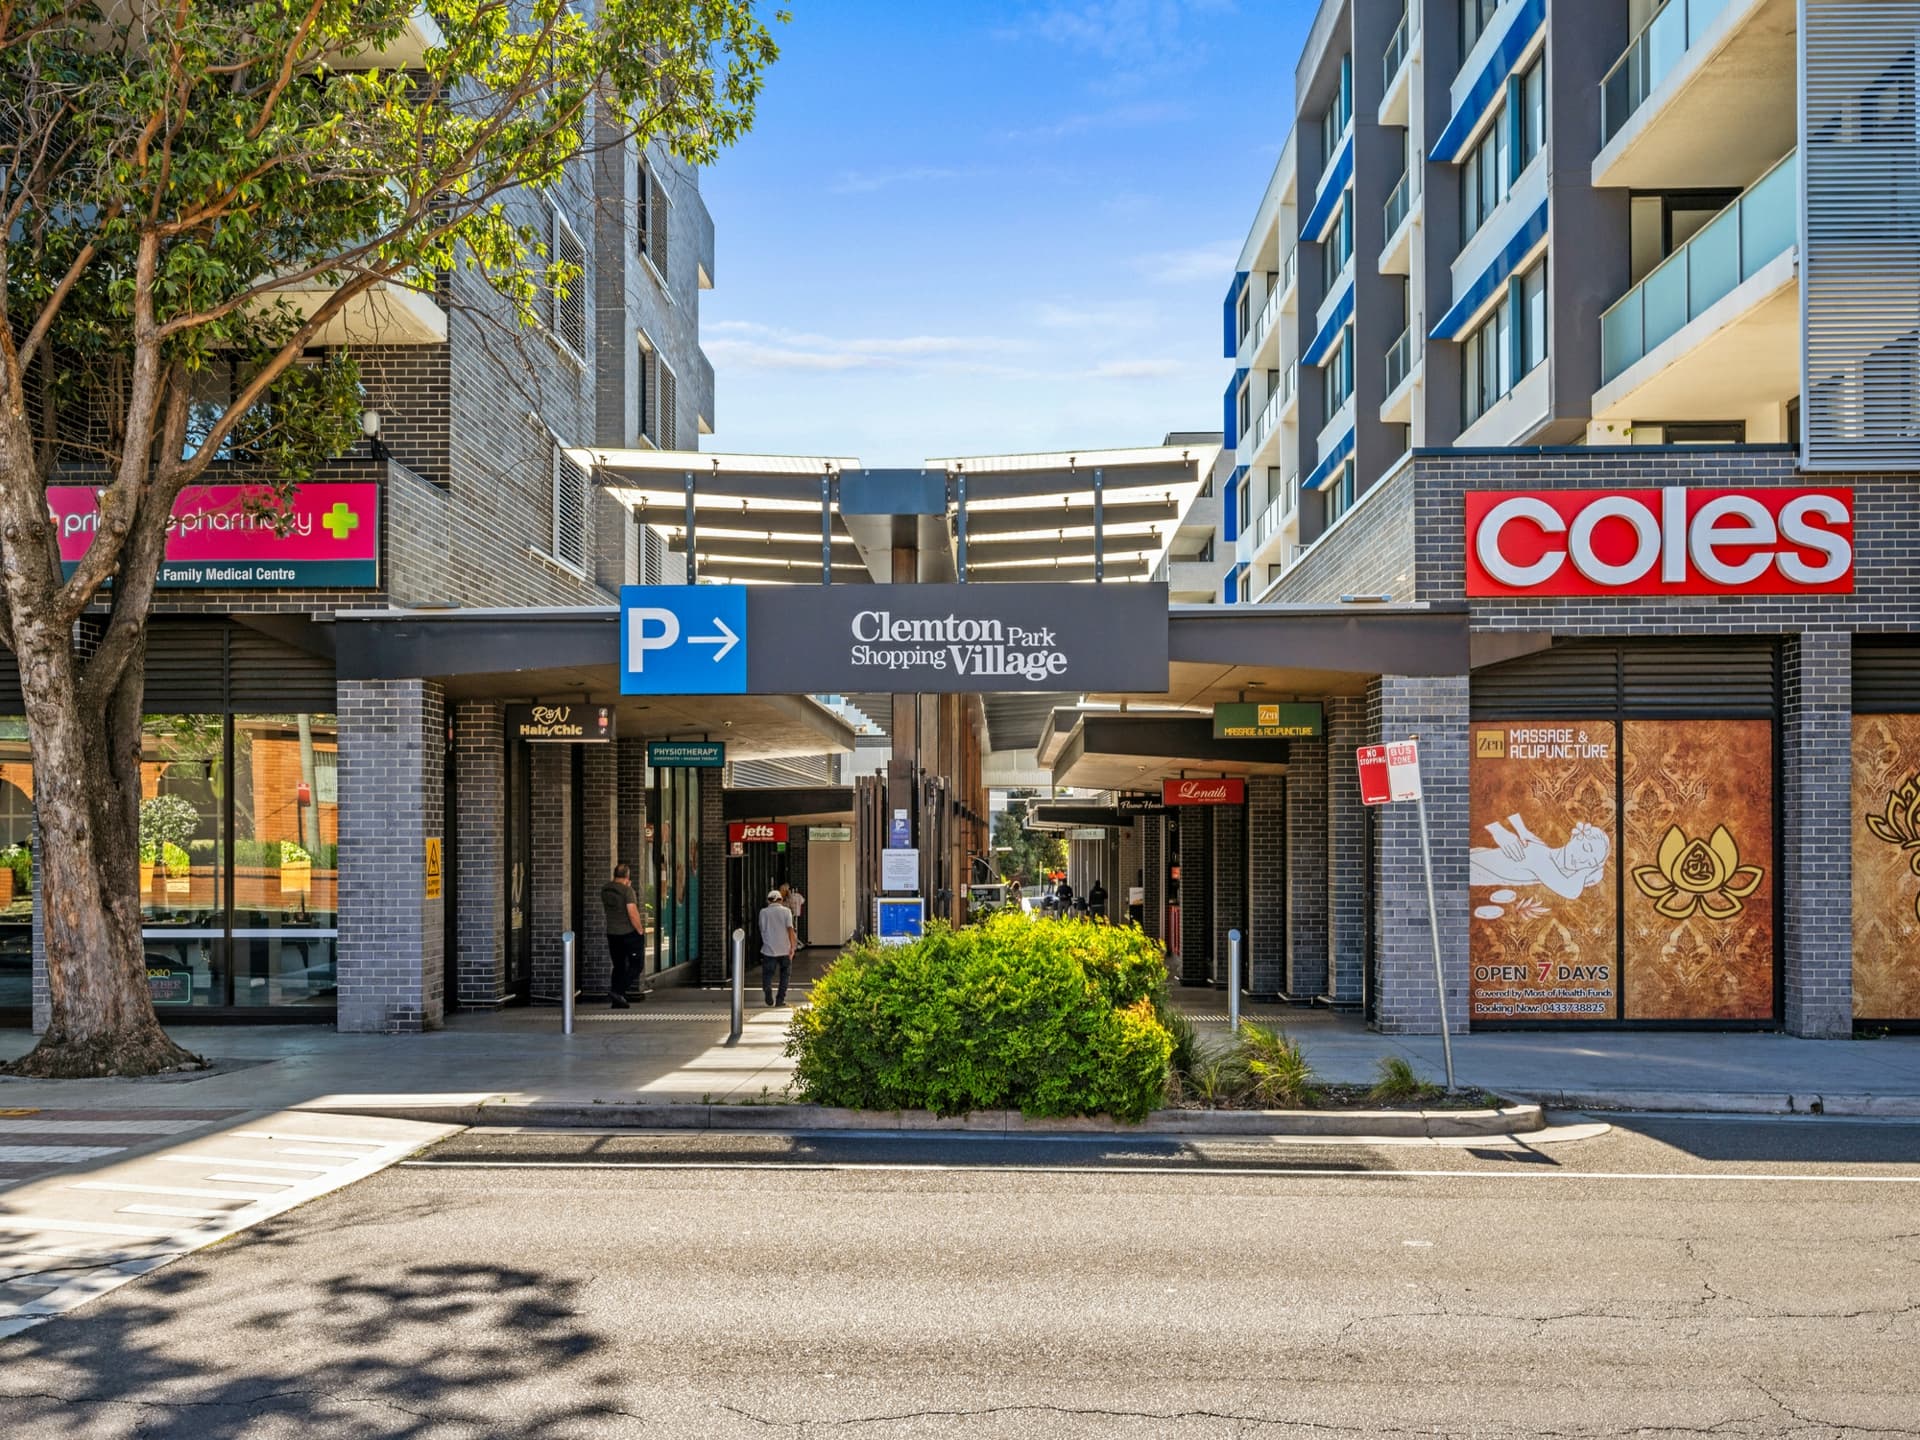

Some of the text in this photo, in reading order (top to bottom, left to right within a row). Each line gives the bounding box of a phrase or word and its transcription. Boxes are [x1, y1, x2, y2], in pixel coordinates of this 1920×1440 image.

[1476, 486, 1852, 586] coles
[163, 568, 202, 582] Family
[206, 568, 252, 580] Medical
[256, 568, 296, 580] Centre
[851, 611, 1056, 647] Clemton Park
[628, 607, 680, 673] P
[851, 645, 1068, 681] Shopping Village
[1260, 710, 1278, 720] Zen
[1224, 728, 1256, 736] MASSAGE
[1264, 727, 1313, 736] ACUPUNCTURE
[1510, 729, 1588, 743] MASSAGE &
[1479, 738, 1503, 751] Zen
[654, 747, 718, 756] PHYSIOTHERAPY
[1366, 749, 1377, 758] NO
[1390, 747, 1411, 757] BUS
[1510, 745, 1608, 759] ACUPUNCTURE
[1360, 757, 1386, 766] STOPPING
[1392, 756, 1411, 766] ZONE
[742, 825, 775, 839] jetts
[1475, 963, 1609, 982] OPEN 7 DAYS
[1475, 989, 1613, 999] Covered by Most of Health Funds
[1475, 1003, 1605, 1015] Booking Now: 0433738825
